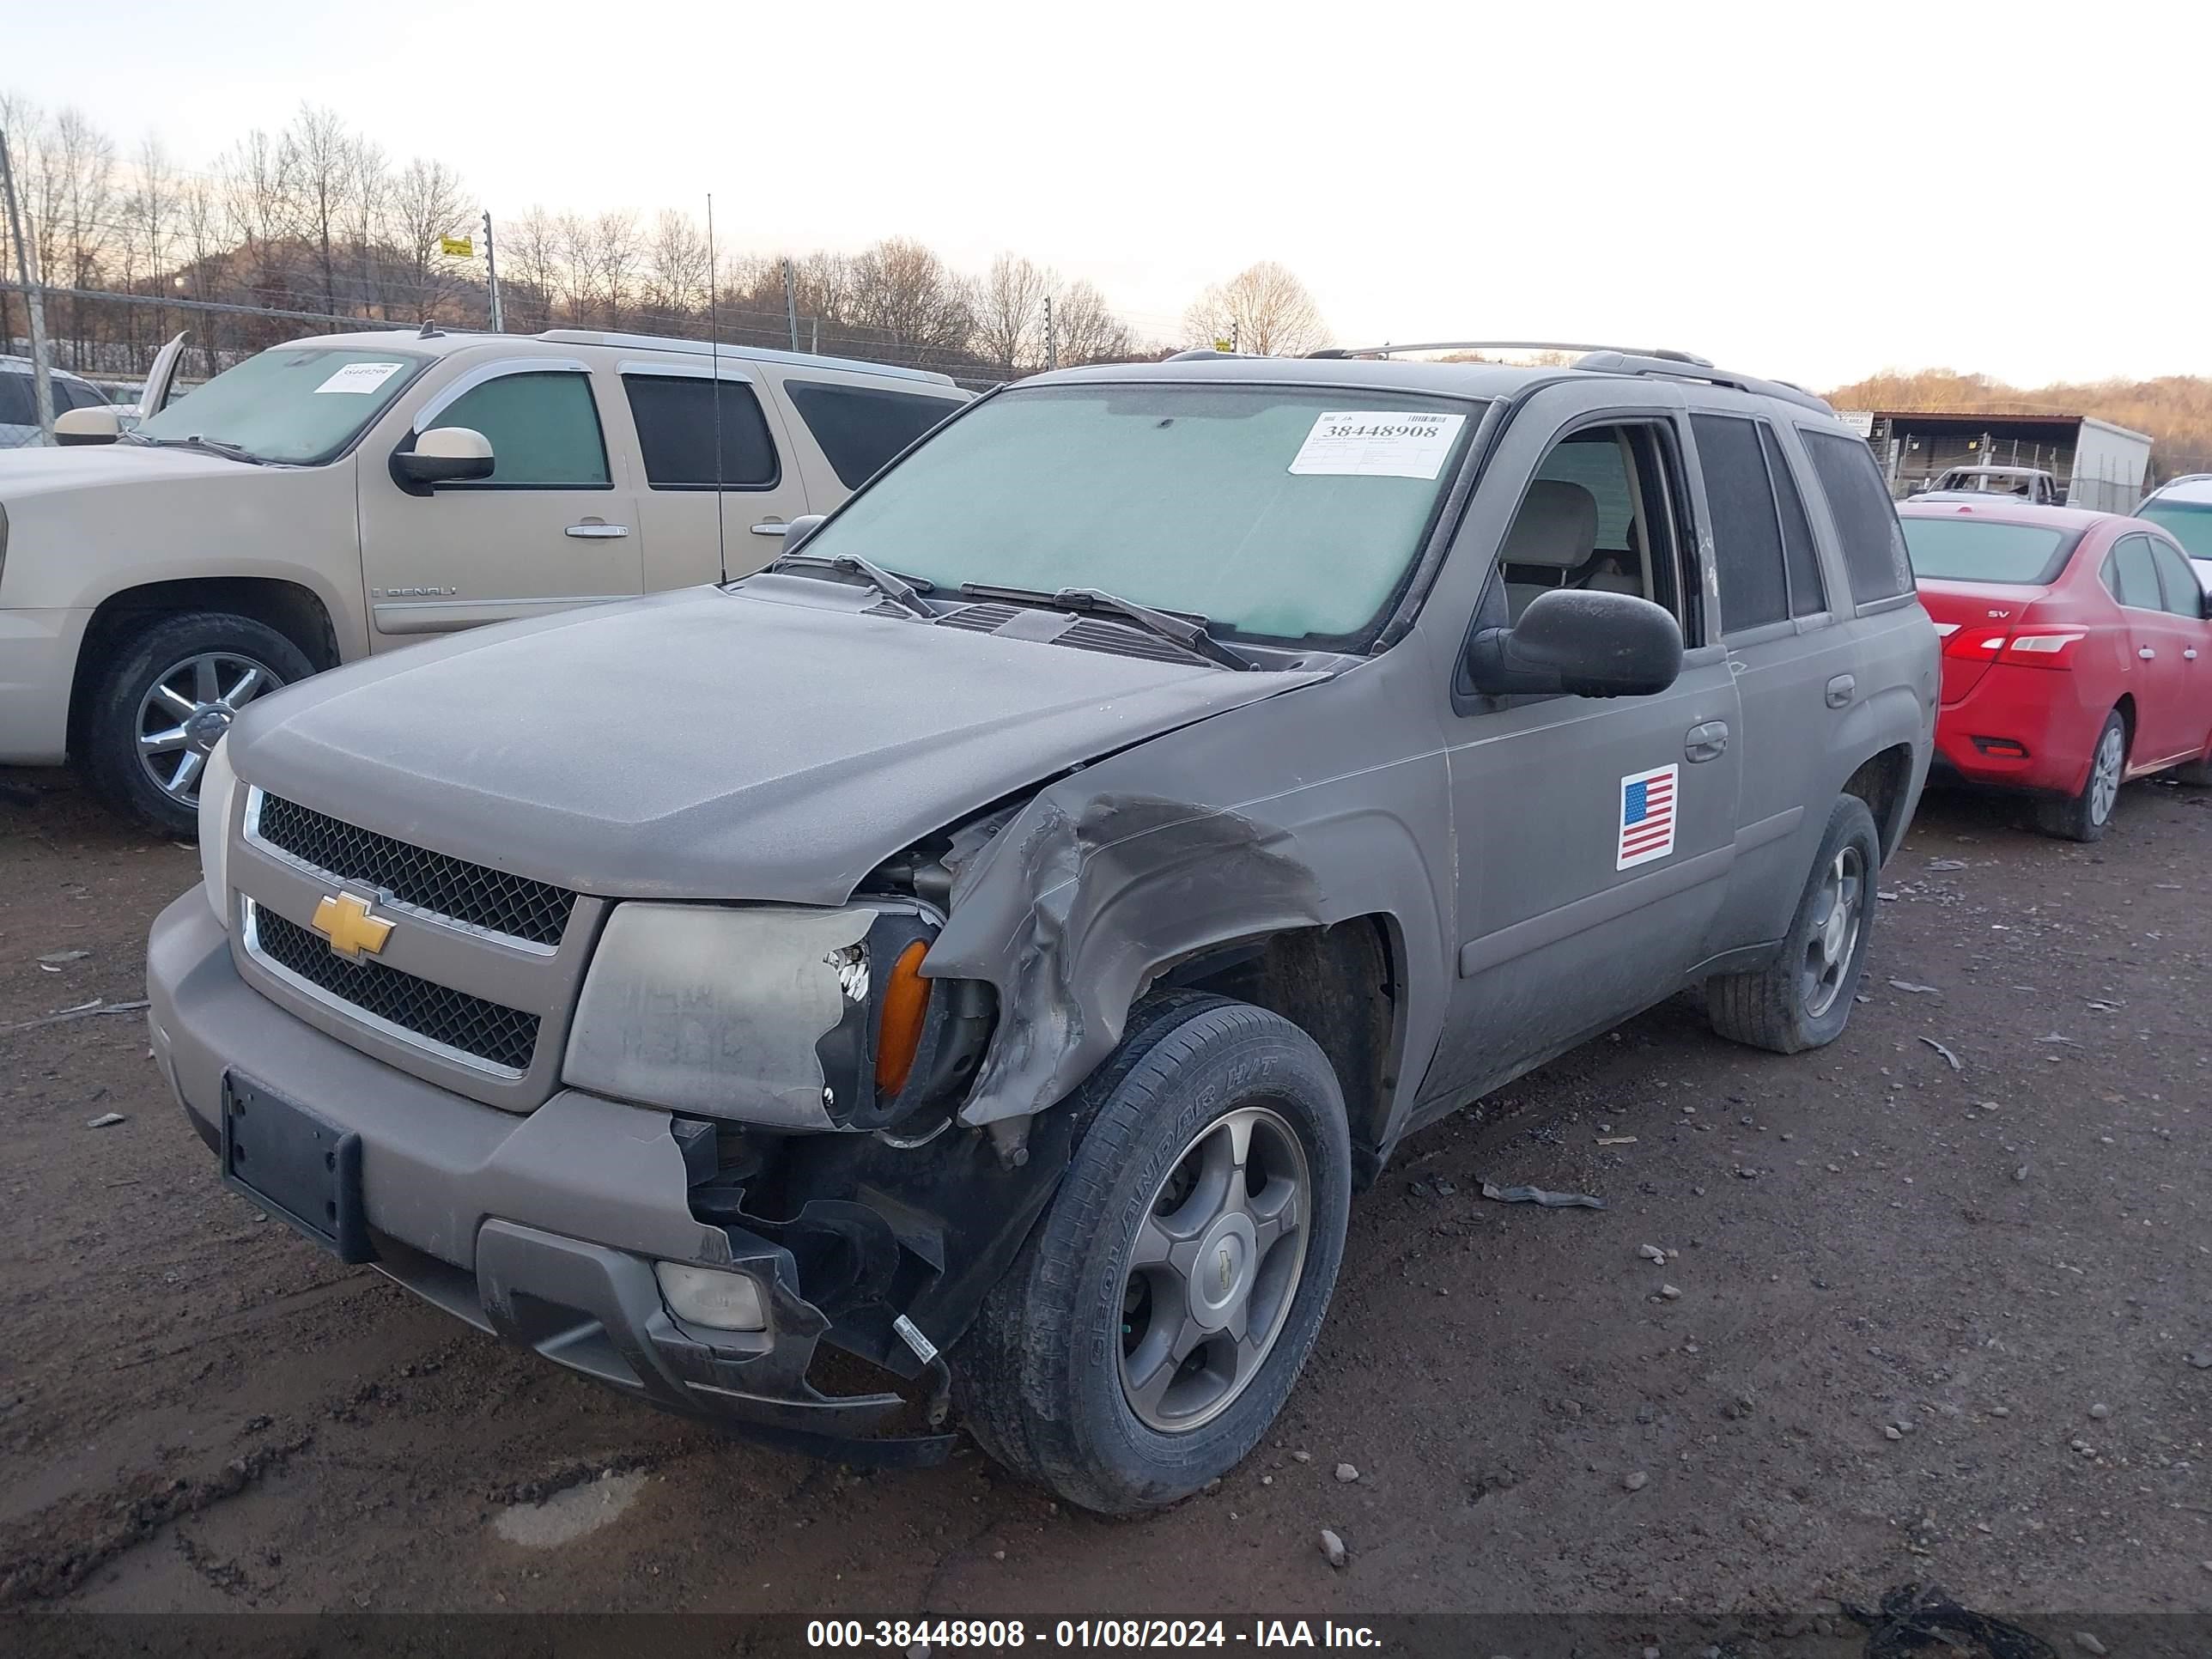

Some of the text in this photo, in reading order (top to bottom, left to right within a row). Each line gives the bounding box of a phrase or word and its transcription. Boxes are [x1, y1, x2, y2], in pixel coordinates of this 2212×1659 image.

[1322, 425, 1439, 438] 38448908
[386, 587, 456, 597] DENALI
[1988, 610, 2010, 618] SV
[1090, 1056, 1278, 1365] GEOLANDAR H/T
